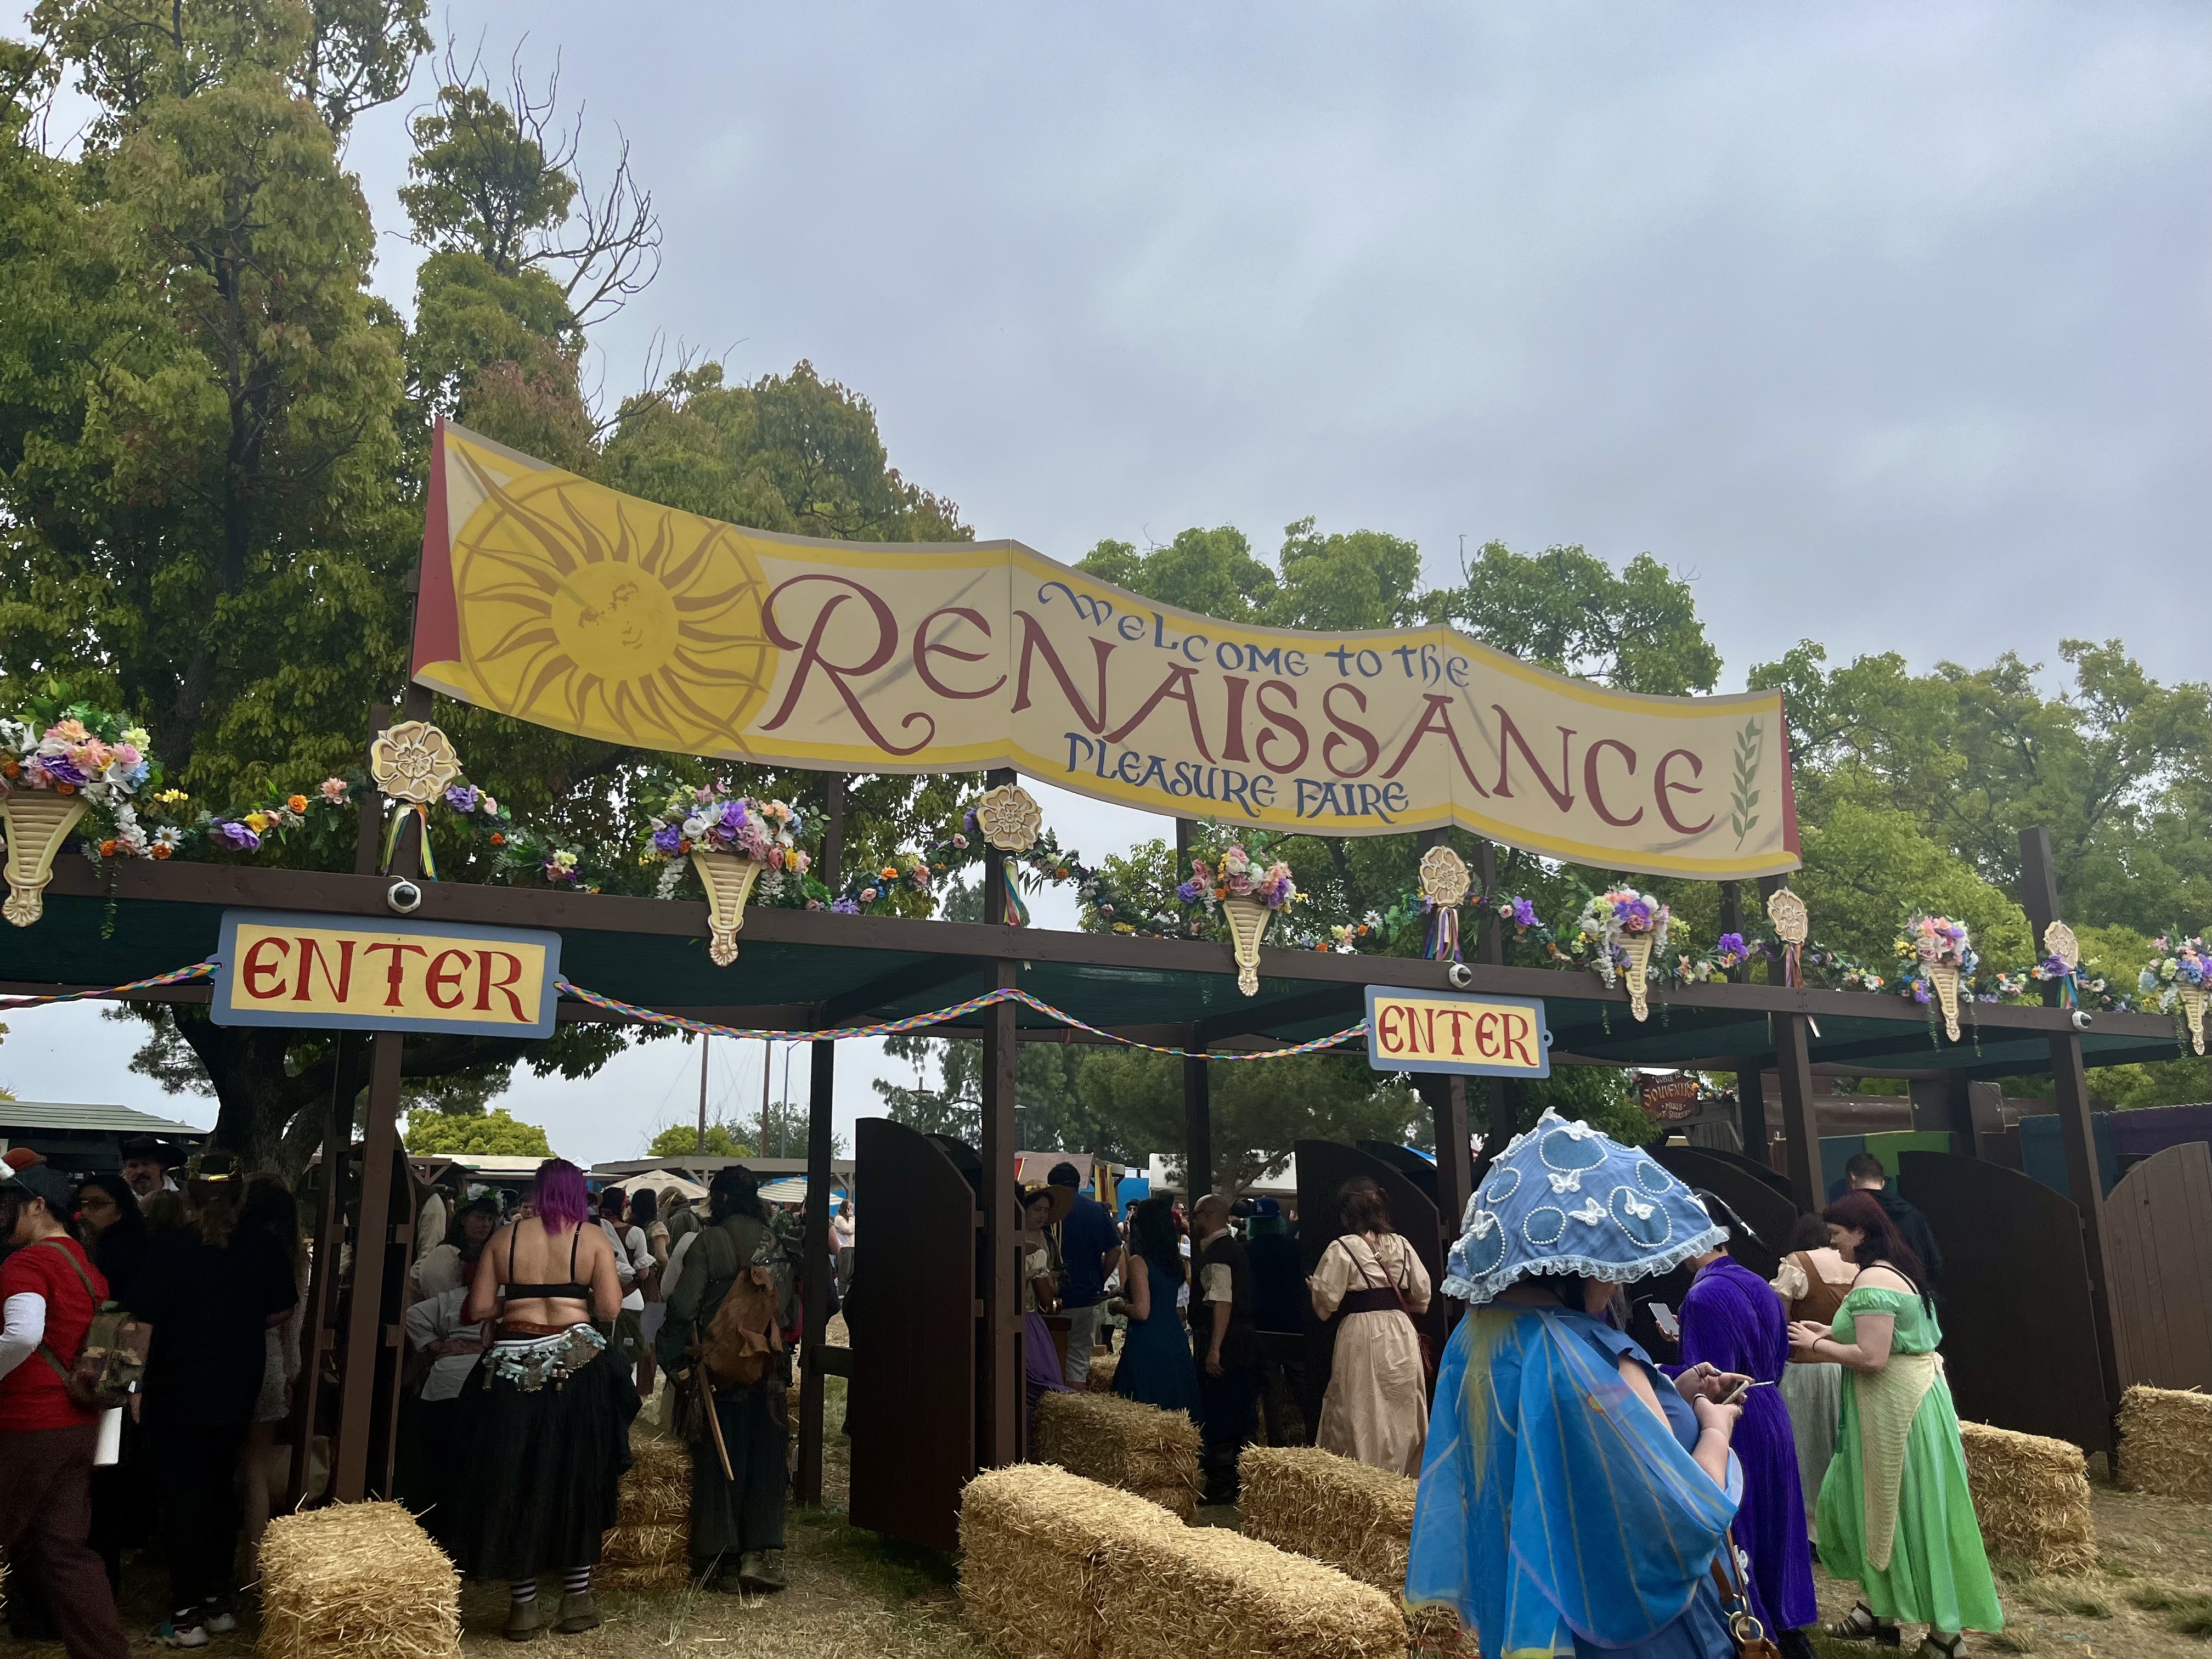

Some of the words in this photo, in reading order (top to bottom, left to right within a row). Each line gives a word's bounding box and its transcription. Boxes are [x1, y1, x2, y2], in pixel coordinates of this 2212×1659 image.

[1038, 582, 1309, 676] WELCOME
[1325, 644, 1383, 678] to
[1391, 644, 1470, 688] the
[758, 574, 1714, 834] RENAISSANCE
[1064, 732, 1277, 818] PLEASURE
[1293, 778, 1409, 824] FAIRE
[242, 937, 533, 1023] ENTER
[1379, 1005, 1538, 1066] ENTER
[1665, 1102, 1683, 1111] MUGS
